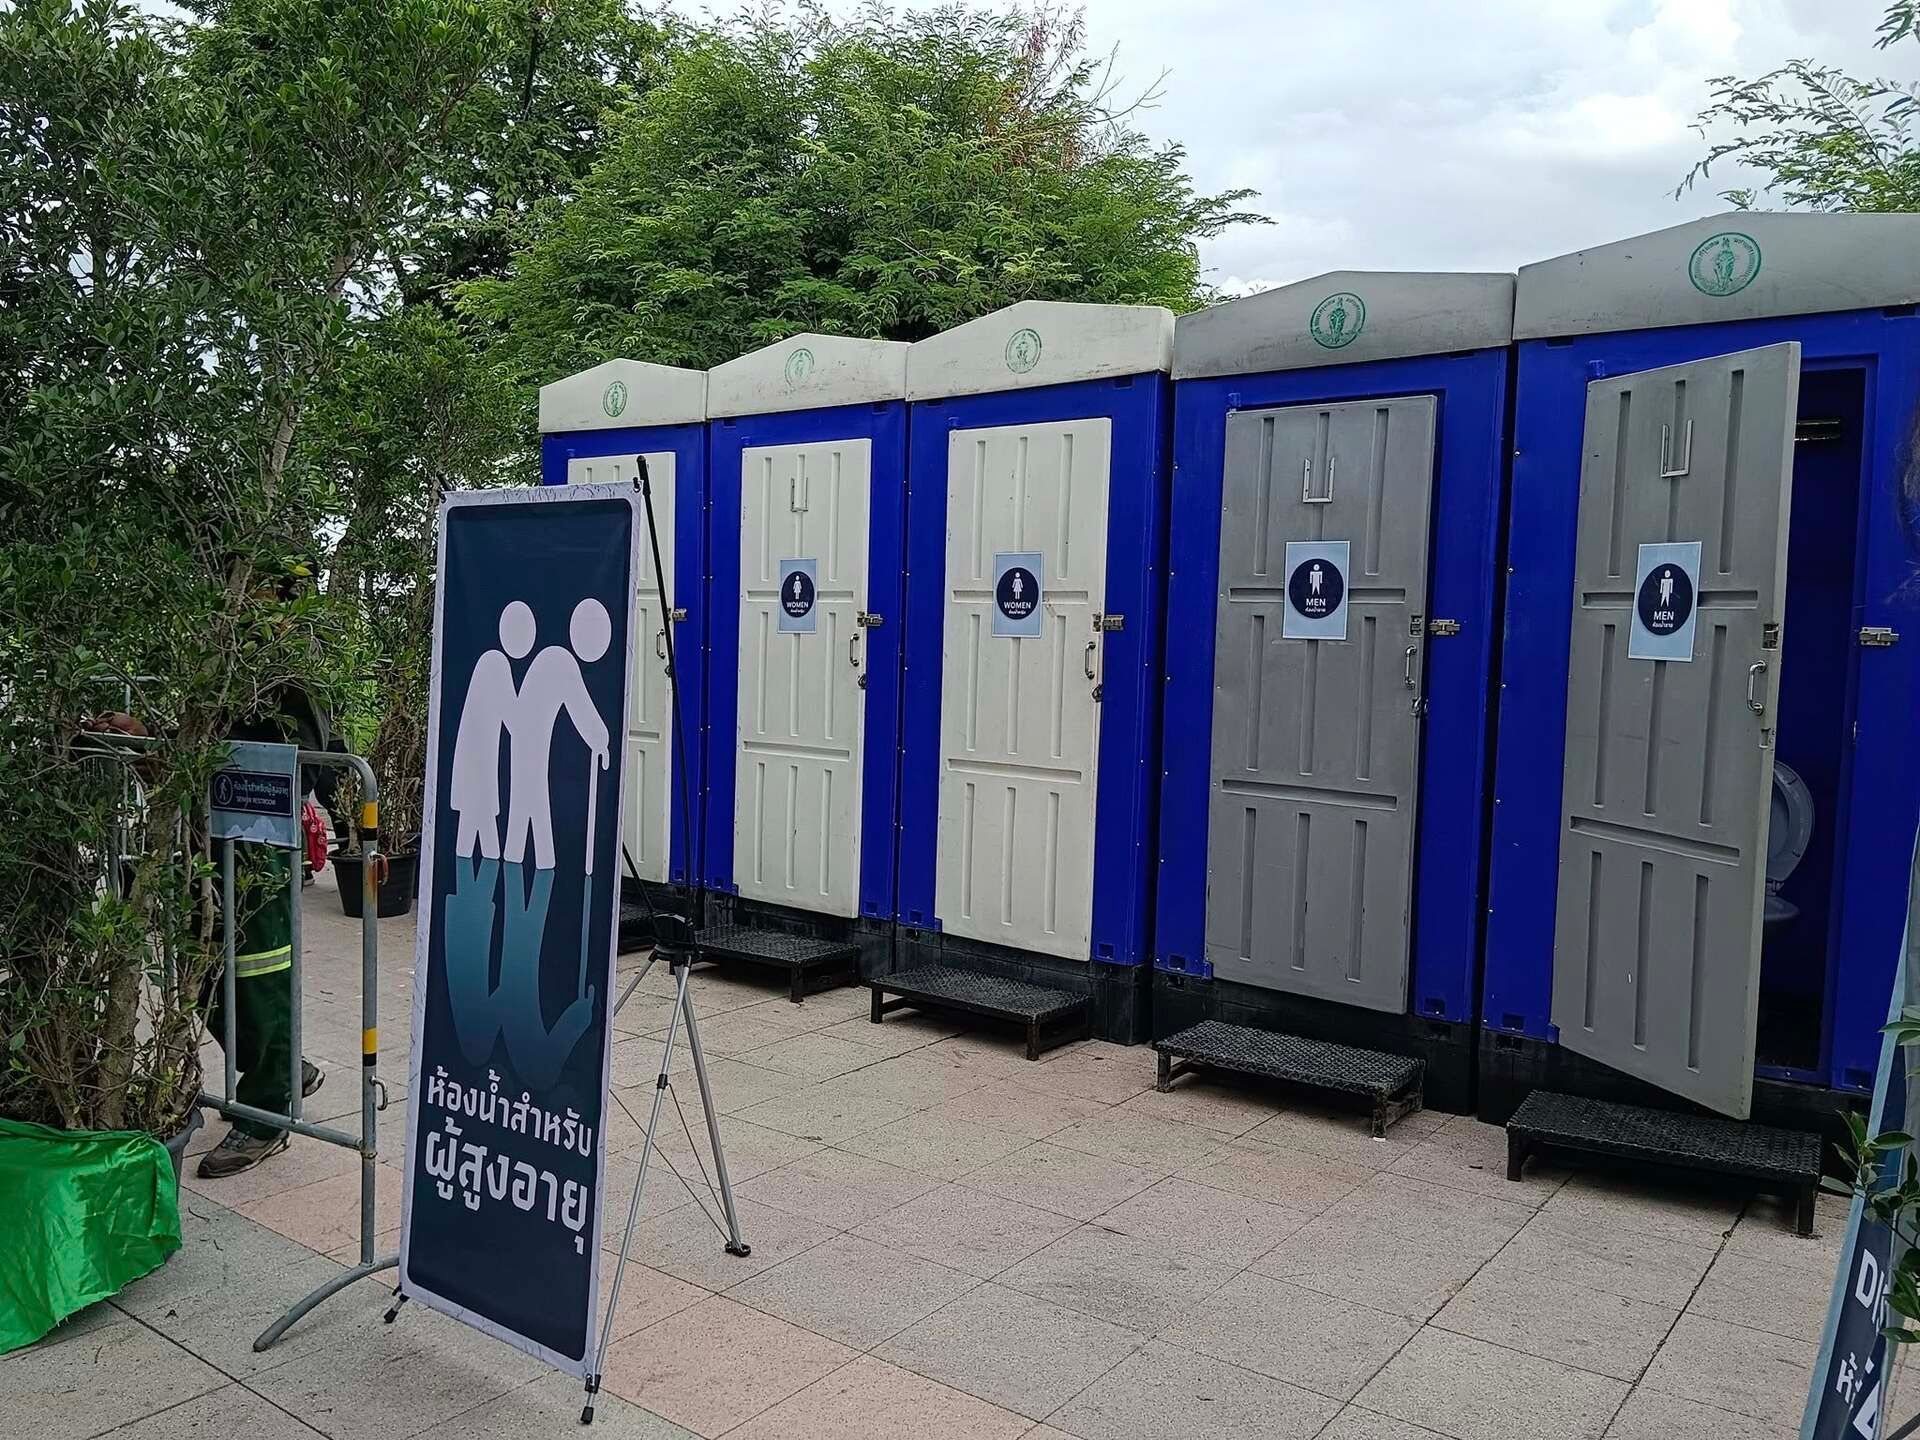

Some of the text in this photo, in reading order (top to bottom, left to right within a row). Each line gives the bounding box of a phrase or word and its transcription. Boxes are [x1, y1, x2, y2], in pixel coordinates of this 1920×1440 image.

[1003, 601, 1031, 609] WOMEN
[1306, 598, 1326, 606] MEN
[1653, 611, 1674, 620] MEN
[427, 1065, 592, 1158] ห้องน้ำสำหรับ
[425, 1116, 588, 1255] ผู้สูงอายุ
